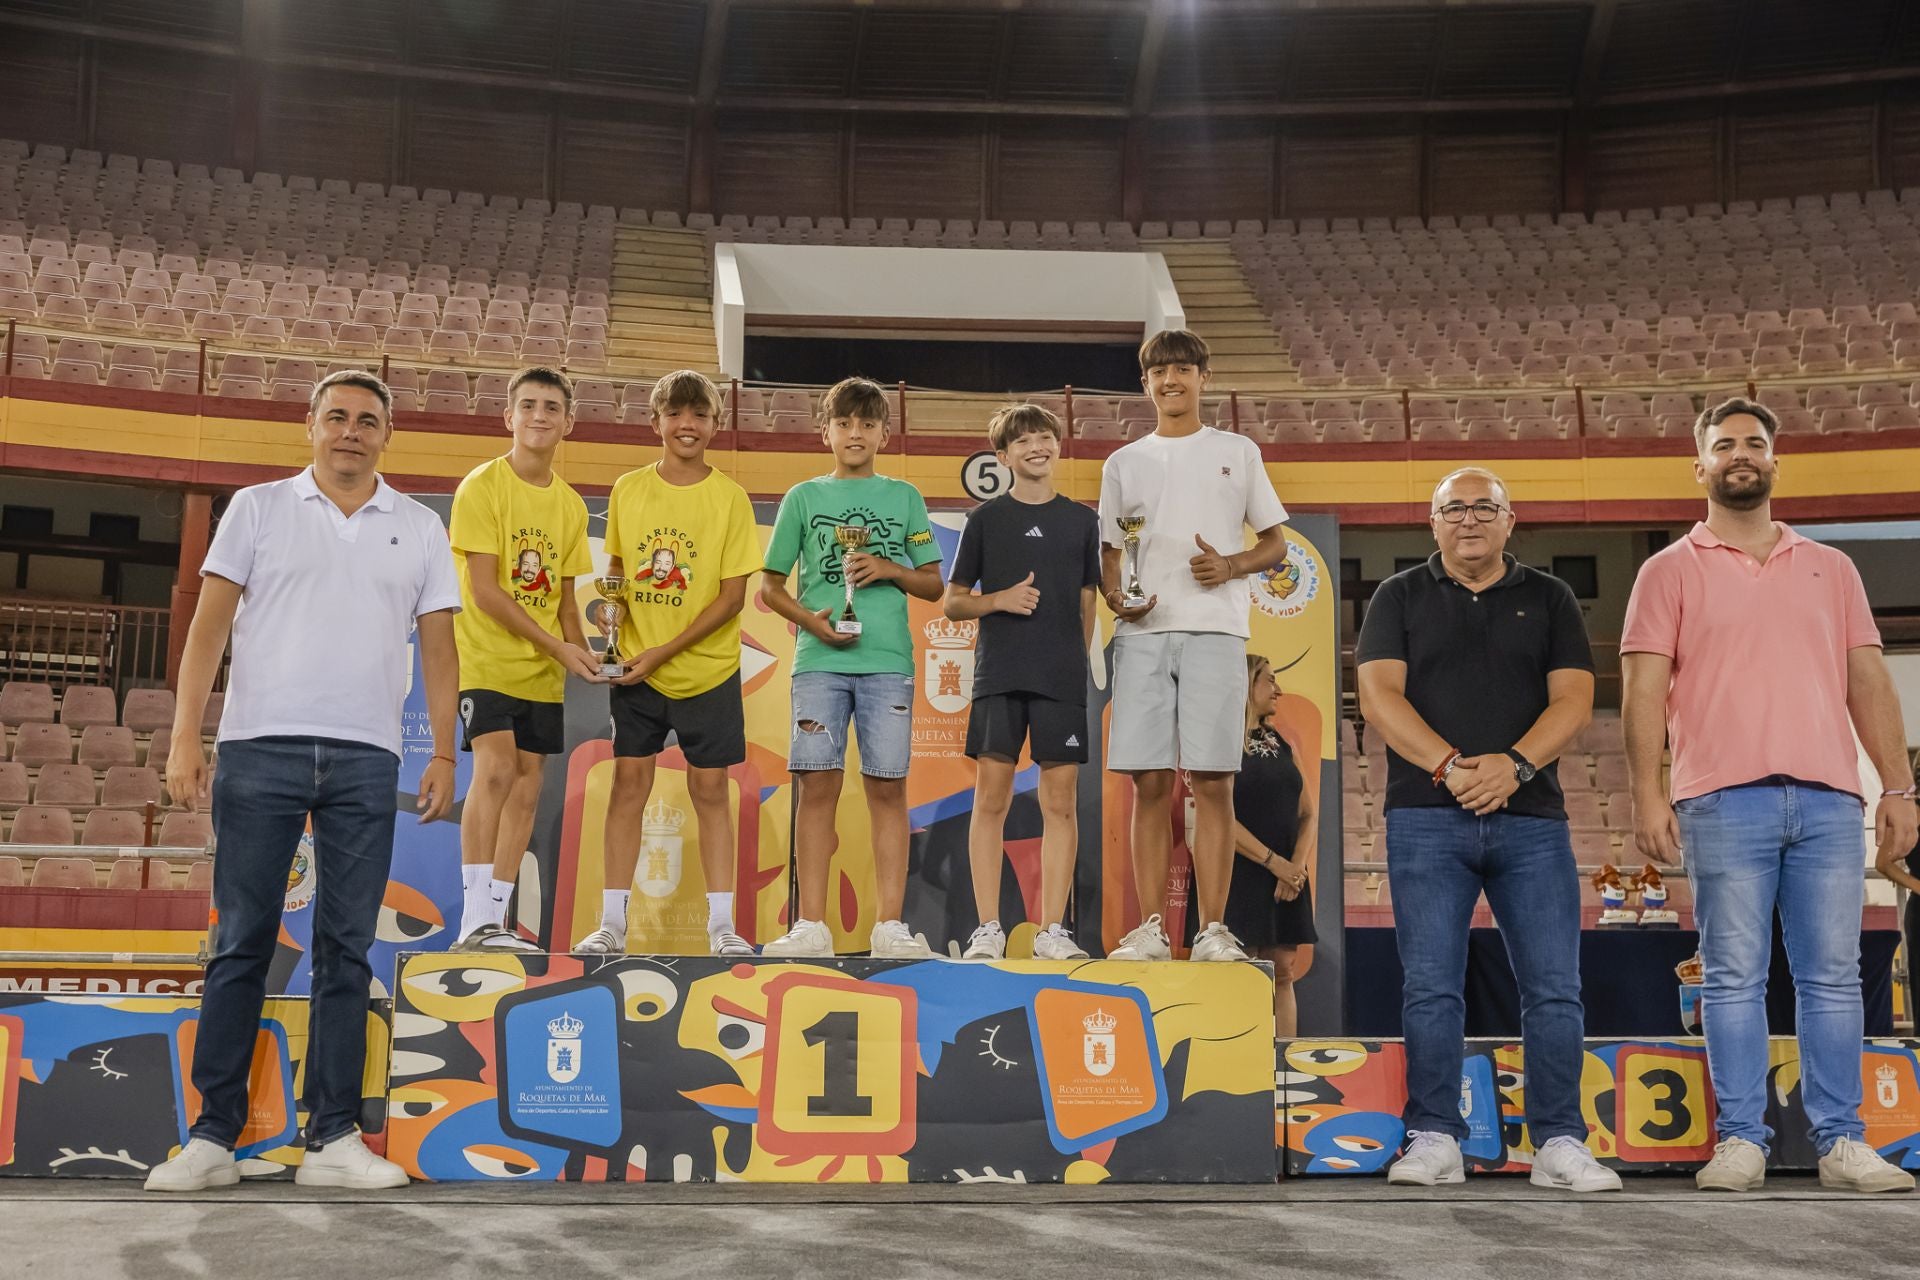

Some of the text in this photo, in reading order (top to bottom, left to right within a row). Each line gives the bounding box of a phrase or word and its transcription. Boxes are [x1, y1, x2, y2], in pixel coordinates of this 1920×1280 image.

[978, 462, 999, 494] 5
[511, 528, 558, 560] ARISCOS
[638, 527, 697, 558] MARISCOS
[635, 591, 682, 607] RECIO
[1279, 605, 1302, 616] VIDA
[461, 697, 474, 729] 9
[285, 899, 306, 910] IDA
[687, 911, 710, 925] MA
[802, 1012, 872, 1116] 1
[519, 1092, 607, 1103] ROQUETAS DE MAR
[1059, 1085, 1104, 1095] ROQUETAS
[1119, 1085, 1140, 1094] MAR
[1638, 1069, 1692, 1141] 3
